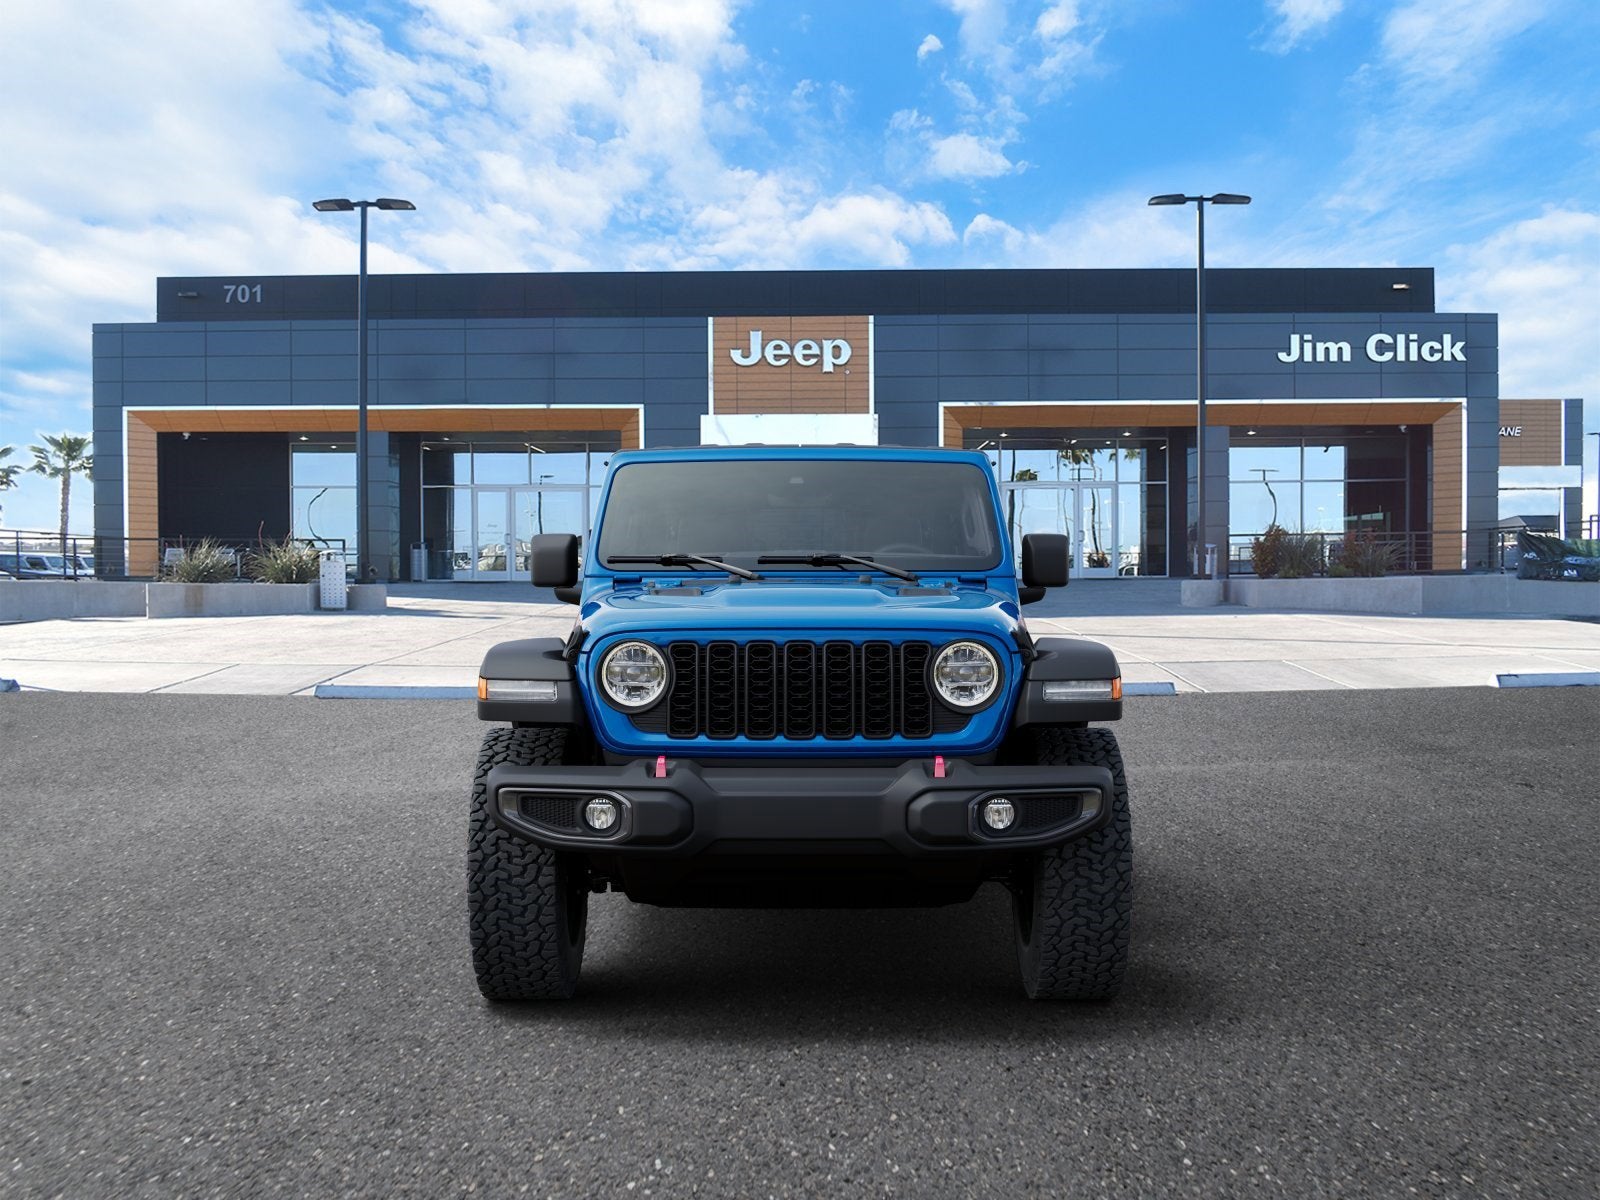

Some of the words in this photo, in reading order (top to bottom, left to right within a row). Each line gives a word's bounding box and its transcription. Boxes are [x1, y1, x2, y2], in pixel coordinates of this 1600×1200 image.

[223, 284, 262, 303] 701
[729, 329, 852, 373] Jeep
[1277, 333, 1352, 363] Jim
[1365, 333, 1467, 363] Click
